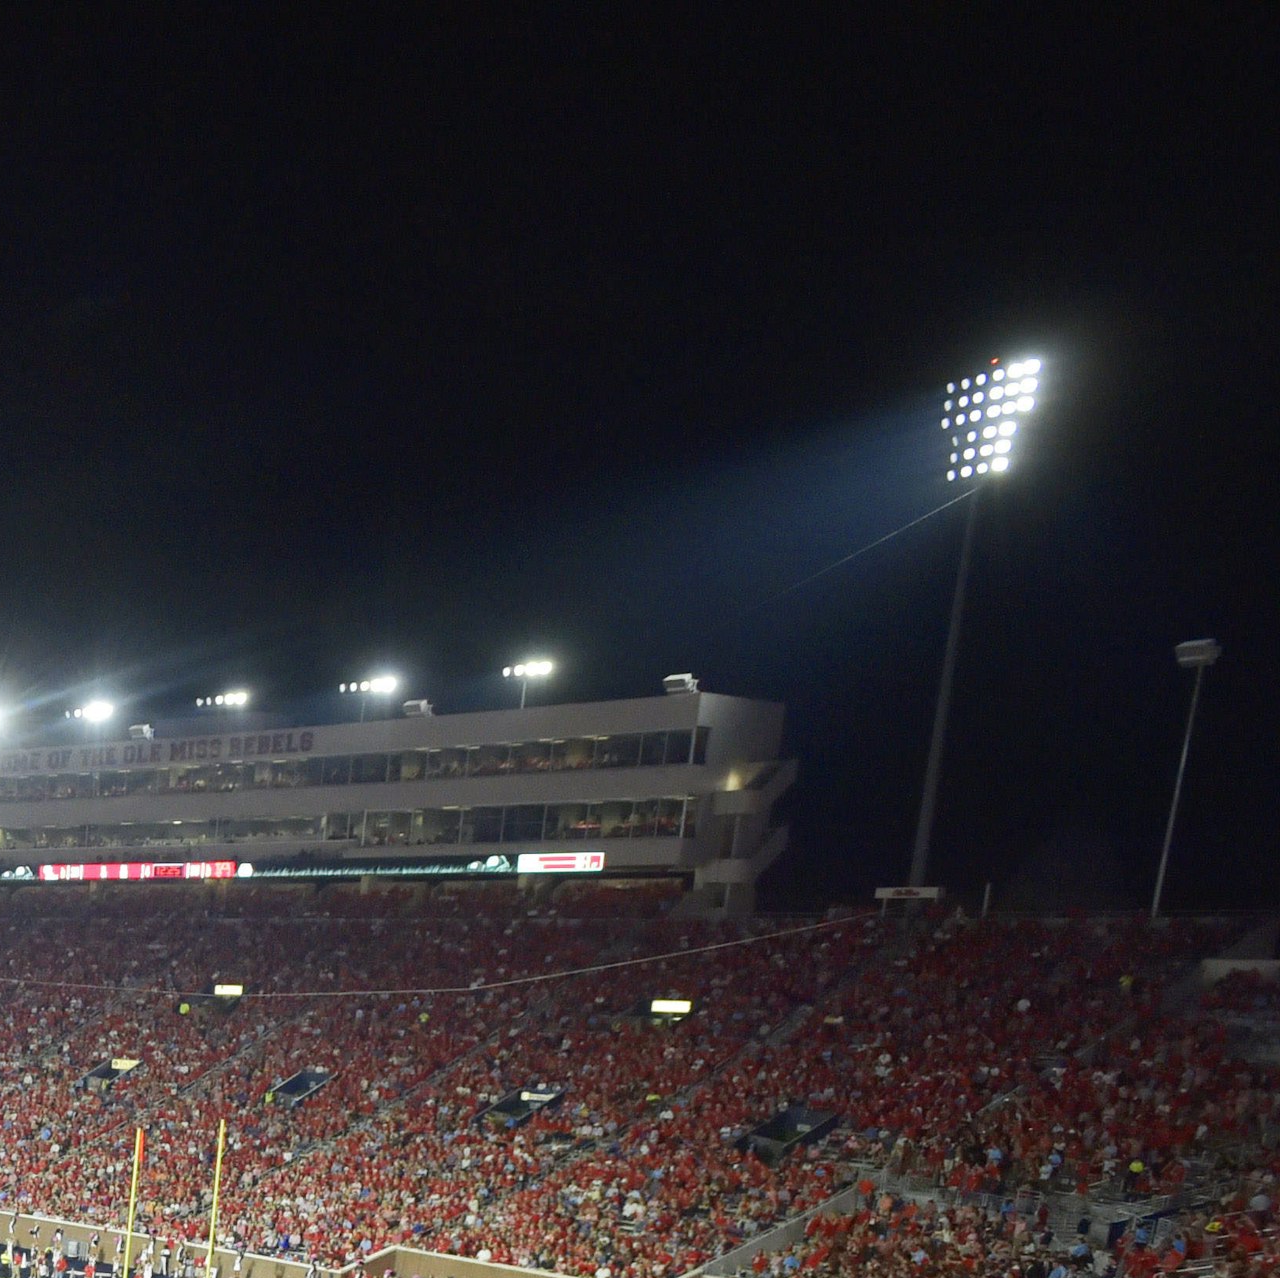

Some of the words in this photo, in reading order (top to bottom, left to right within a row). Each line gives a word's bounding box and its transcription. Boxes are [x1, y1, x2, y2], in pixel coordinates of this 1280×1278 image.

[48, 749, 71, 770] OF
[81, 747, 115, 768] THE
[124, 743, 161, 763] OLE
[169, 738, 221, 761] MISS
[230, 731, 313, 757] REBELS
